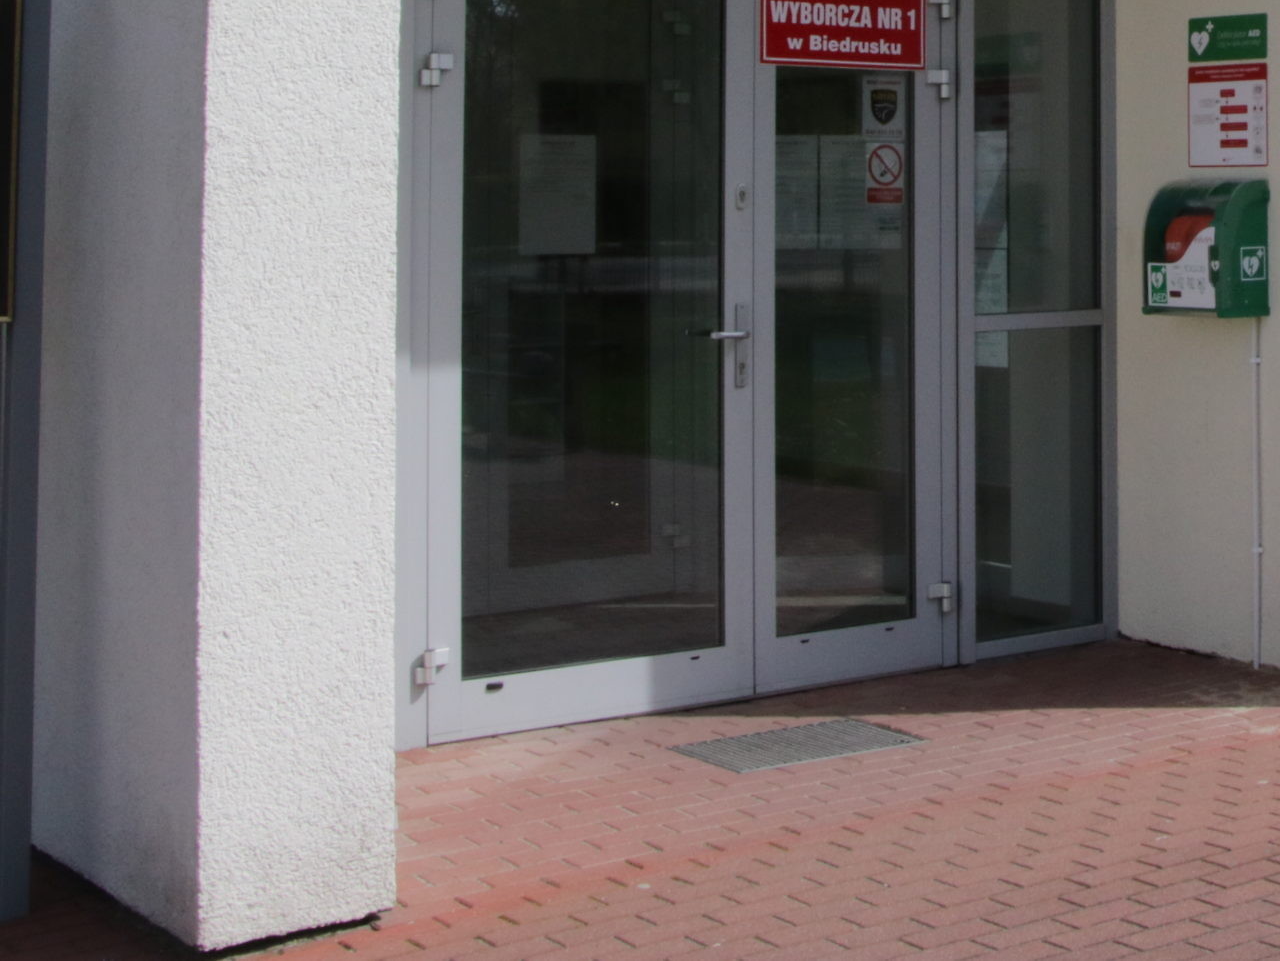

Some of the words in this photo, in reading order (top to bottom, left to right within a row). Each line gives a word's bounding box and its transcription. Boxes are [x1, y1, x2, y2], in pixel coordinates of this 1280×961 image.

[769, 0, 873, 28] WYBORCZA
[877, 7, 902, 30] NR
[907, 9, 917, 31] 1
[786, 37, 804, 51] w
[808, 34, 902, 56] Biedrusku
